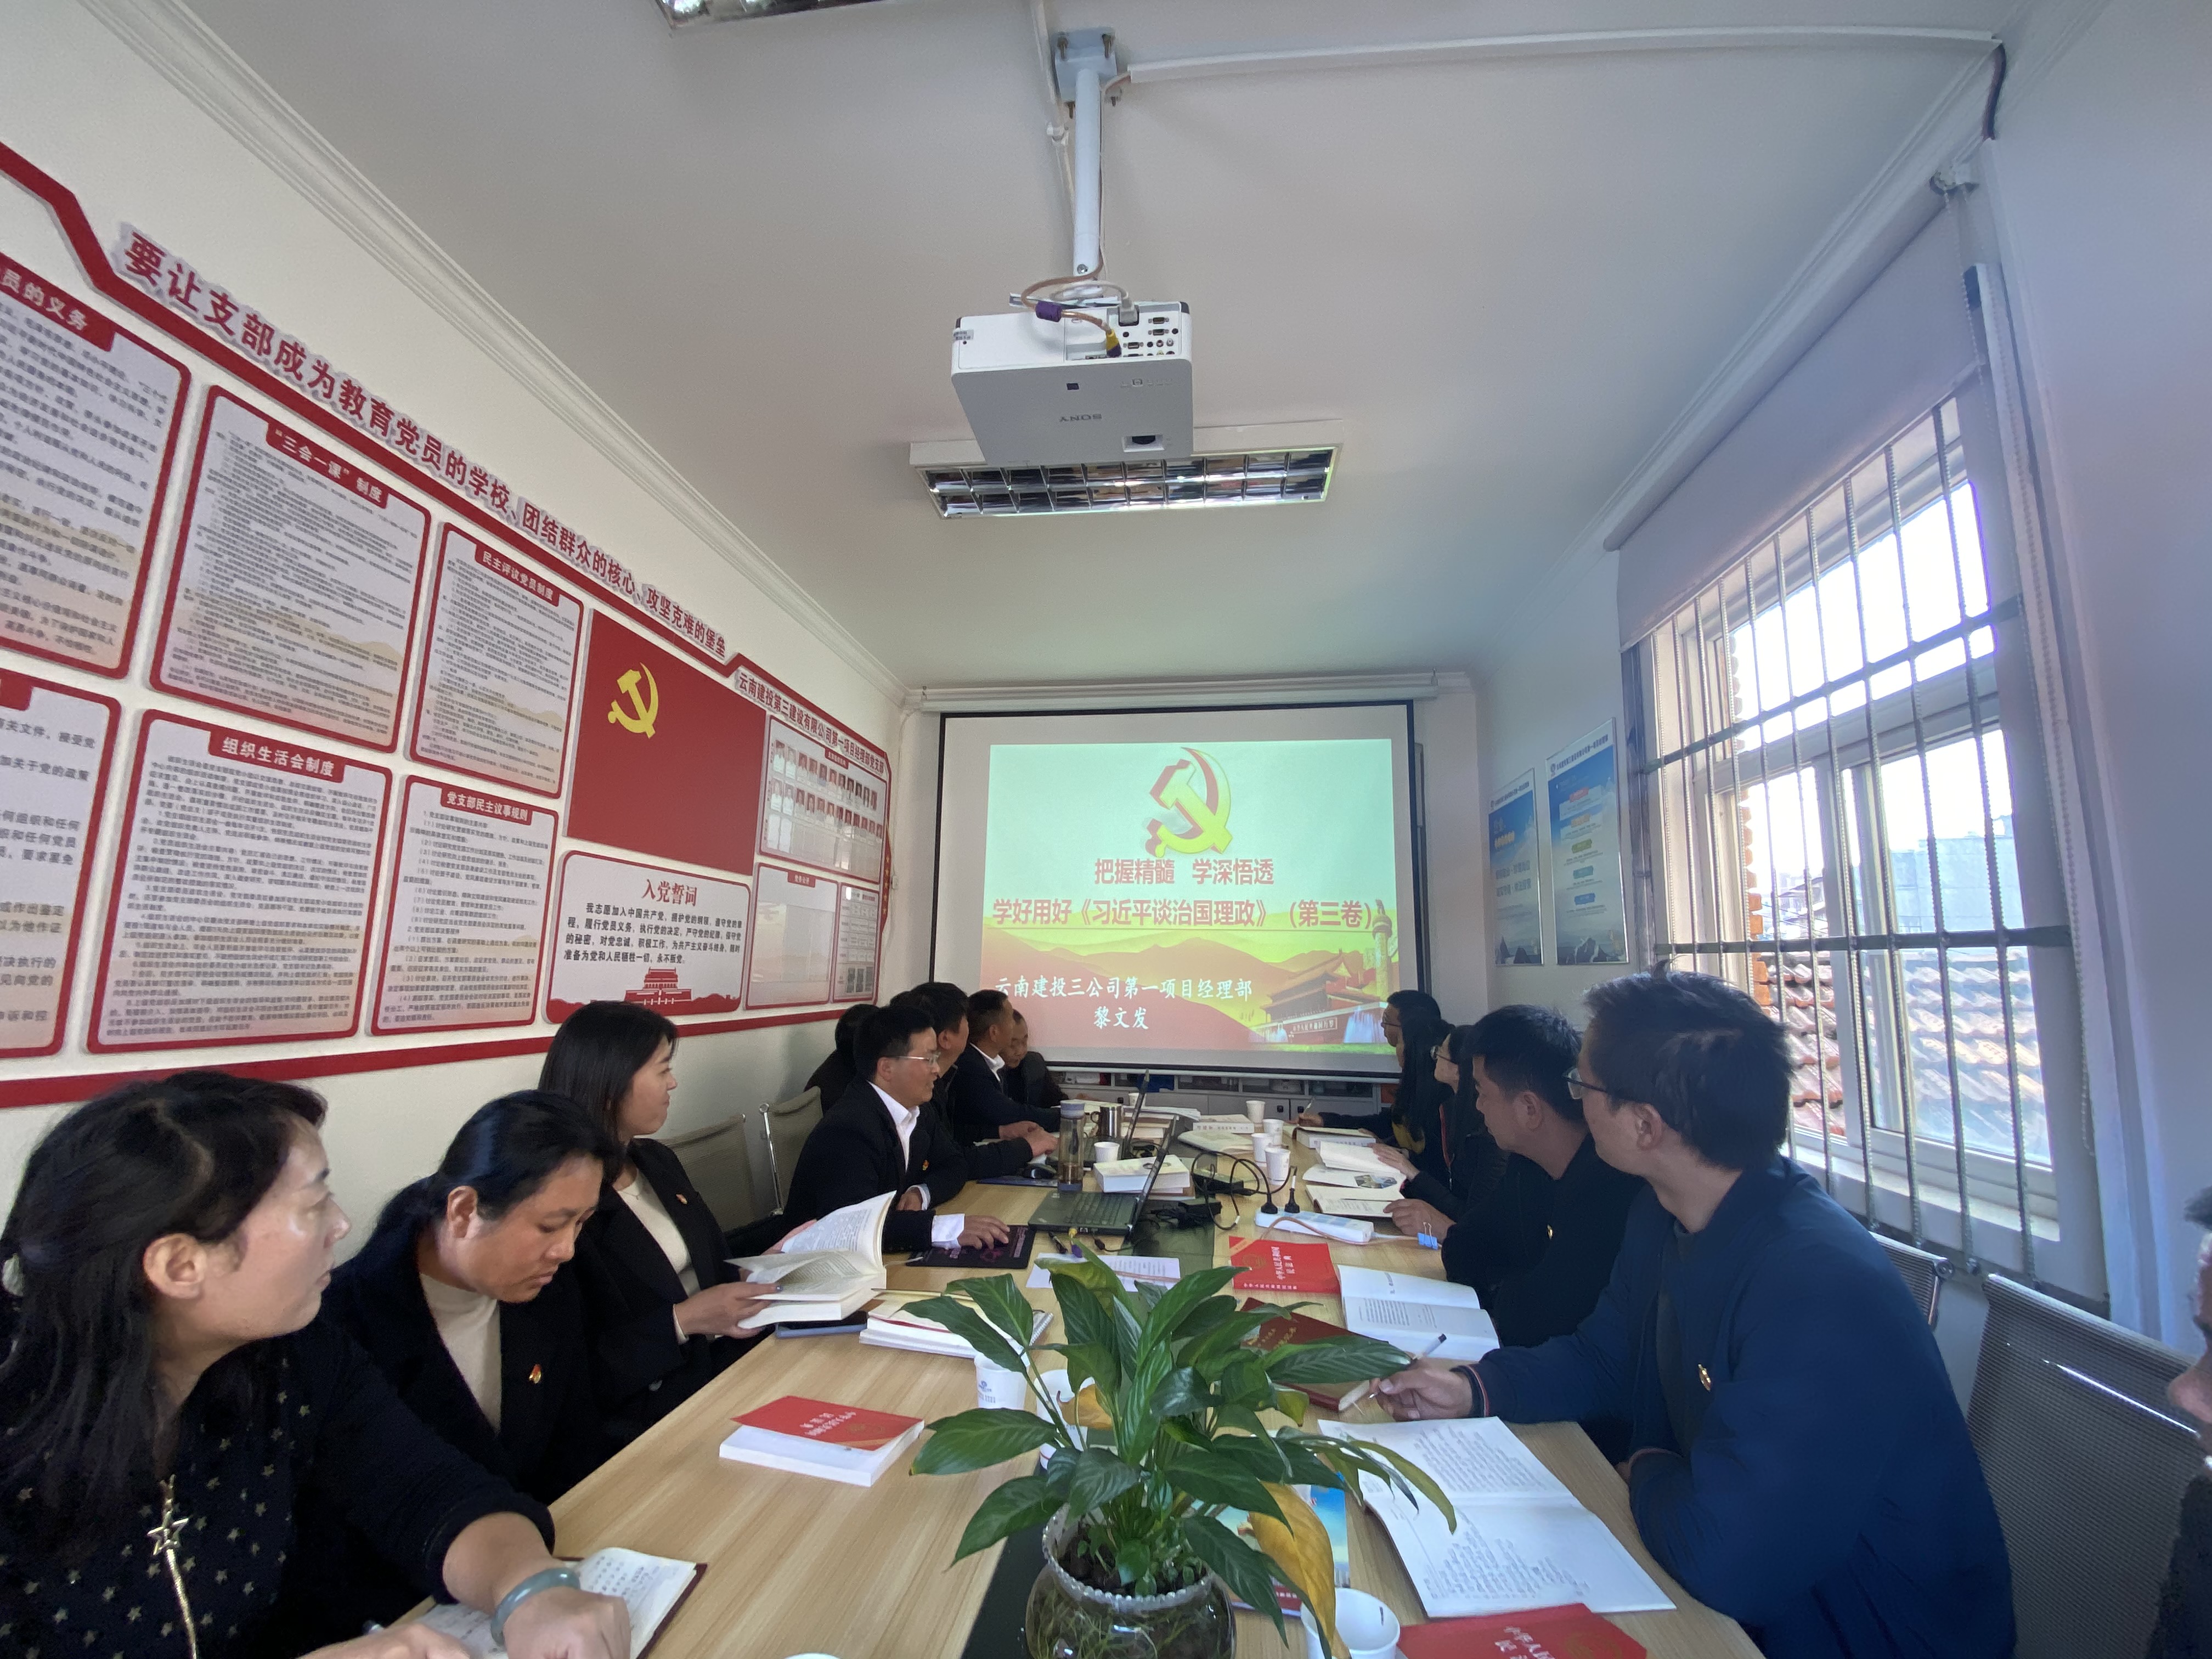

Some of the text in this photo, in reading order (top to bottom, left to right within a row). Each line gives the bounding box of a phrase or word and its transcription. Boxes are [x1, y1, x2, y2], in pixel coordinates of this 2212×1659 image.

[1058, 413, 1102, 422] SONY
[483, 551, 553, 601] 民主评议党员制度
[222, 737, 334, 777] 组织生活会制度
[447, 791, 528, 821] 党支部民主议事规则
[1094, 858, 1274, 885] 把握精髓 学深悟透
[642, 879, 697, 906] 入党誓词
[995, 975, 1252, 1002] 云南建投三公司第一项目经理部
[1093, 1005, 1149, 1029] 黎文发
